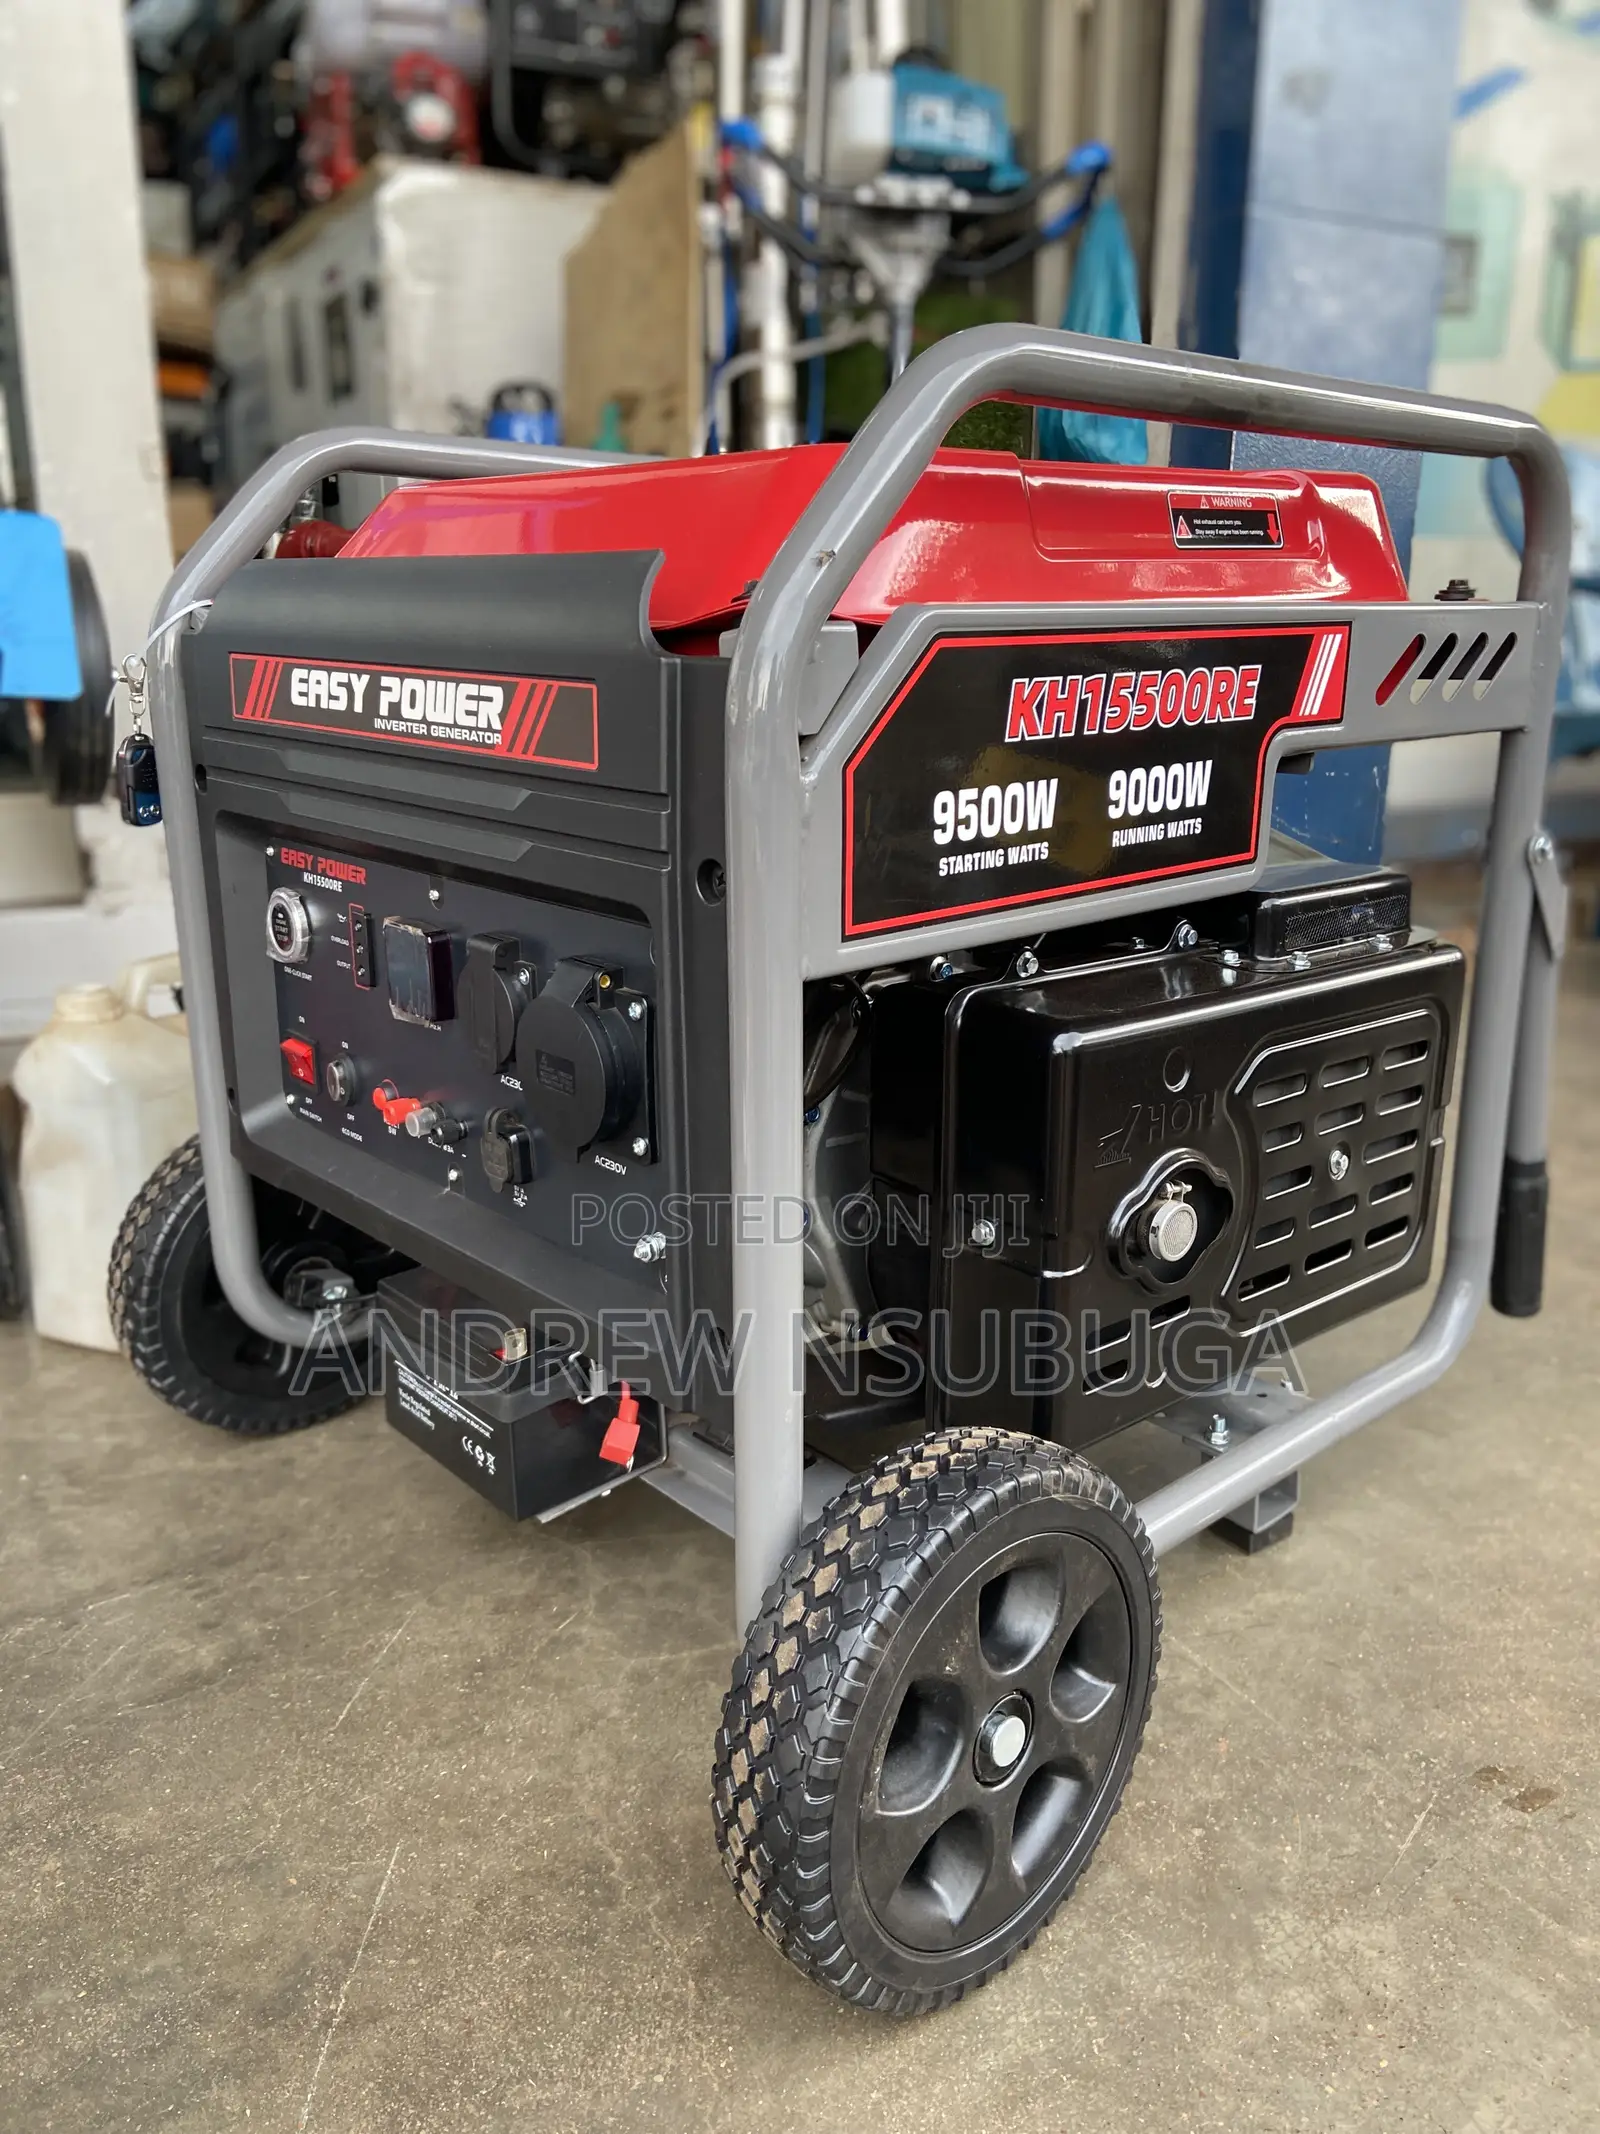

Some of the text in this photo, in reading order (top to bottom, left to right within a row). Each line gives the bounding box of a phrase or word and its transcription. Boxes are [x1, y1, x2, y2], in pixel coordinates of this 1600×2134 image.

[1211, 496, 1252, 508] WARNING
[290, 667, 504, 730] EASY POWER
[1004, 664, 1262, 743] KH15500RE
[374, 718, 502, 745] INVERTER GENERATOR
[1108, 759, 1213, 820] 9000W
[933, 778, 1059, 845] 9500W
[1112, 817, 1202, 848] RUNNING WATTS
[281, 847, 366, 885] EASY POWER
[938, 842, 1049, 877] STARTING WATTS
[303, 872, 343, 892] KH15500RE
[331, 935, 349, 946] OVERLOAD
[336, 960, 351, 970] OUTPUT
[302, 970, 312, 981] START
[299, 1015, 305, 1023] ON
[341, 1041, 349, 1049] ON
[309, 1112, 322, 1122] SWITCH
[347, 1113, 355, 1121] OFF
[350, 1132, 363, 1142] MODE
[594, 1155, 627, 1175] AC230V
